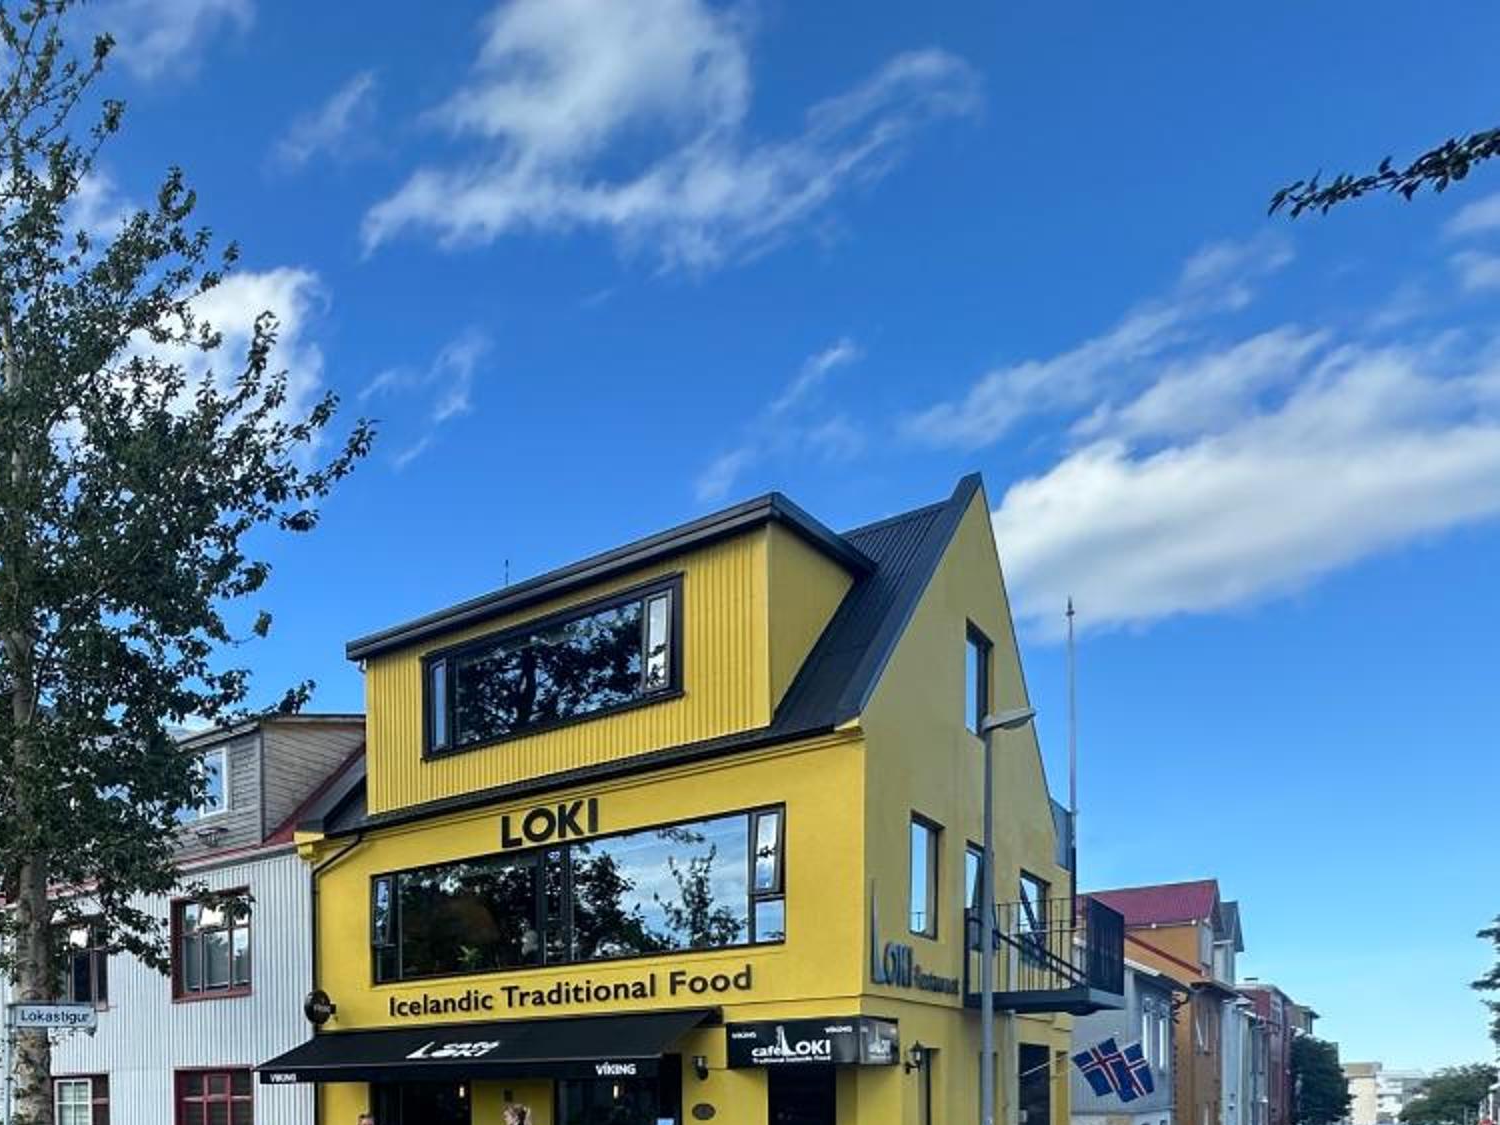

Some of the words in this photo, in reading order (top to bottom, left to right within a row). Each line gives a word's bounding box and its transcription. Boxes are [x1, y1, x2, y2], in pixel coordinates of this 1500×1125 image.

[501, 798, 599, 849] LOKI
[389, 989, 493, 1017] Icelandic
[500, 972, 656, 1009] Traditional
[669, 963, 752, 996] Food
